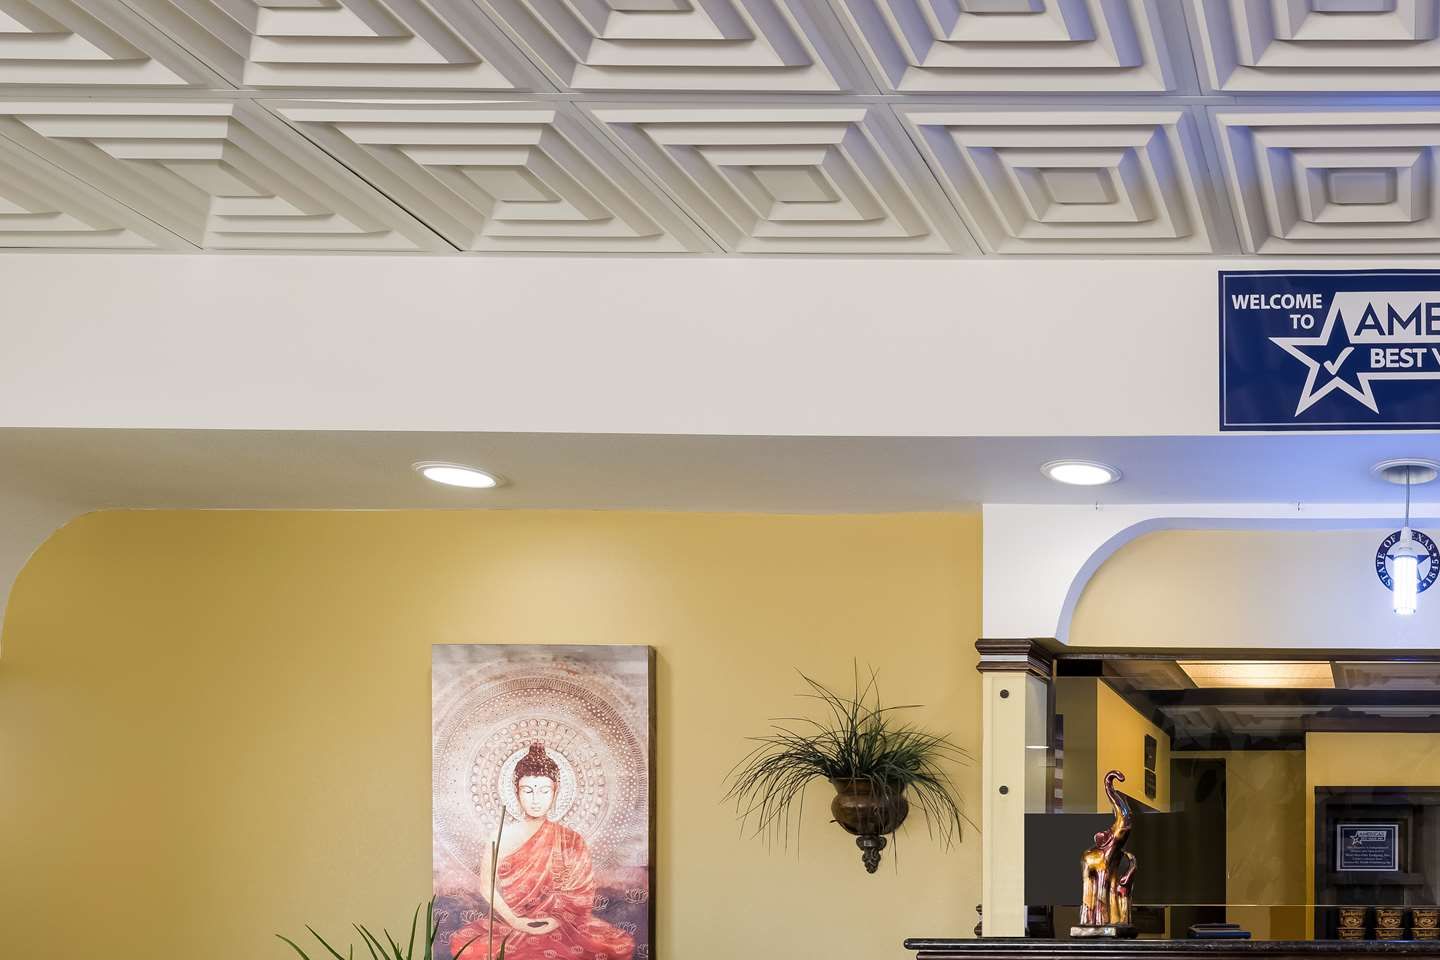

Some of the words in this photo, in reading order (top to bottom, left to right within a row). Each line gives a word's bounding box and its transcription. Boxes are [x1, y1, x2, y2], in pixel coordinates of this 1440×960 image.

[1231, 294, 1323, 310] WELCOME
[1289, 314, 1315, 330] TO
[1370, 348, 1427, 369] BEST
[1383, 535, 1396, 549] OF
[1411, 531, 1435, 551] EXAS
[1376, 552, 1393, 586] STATE
